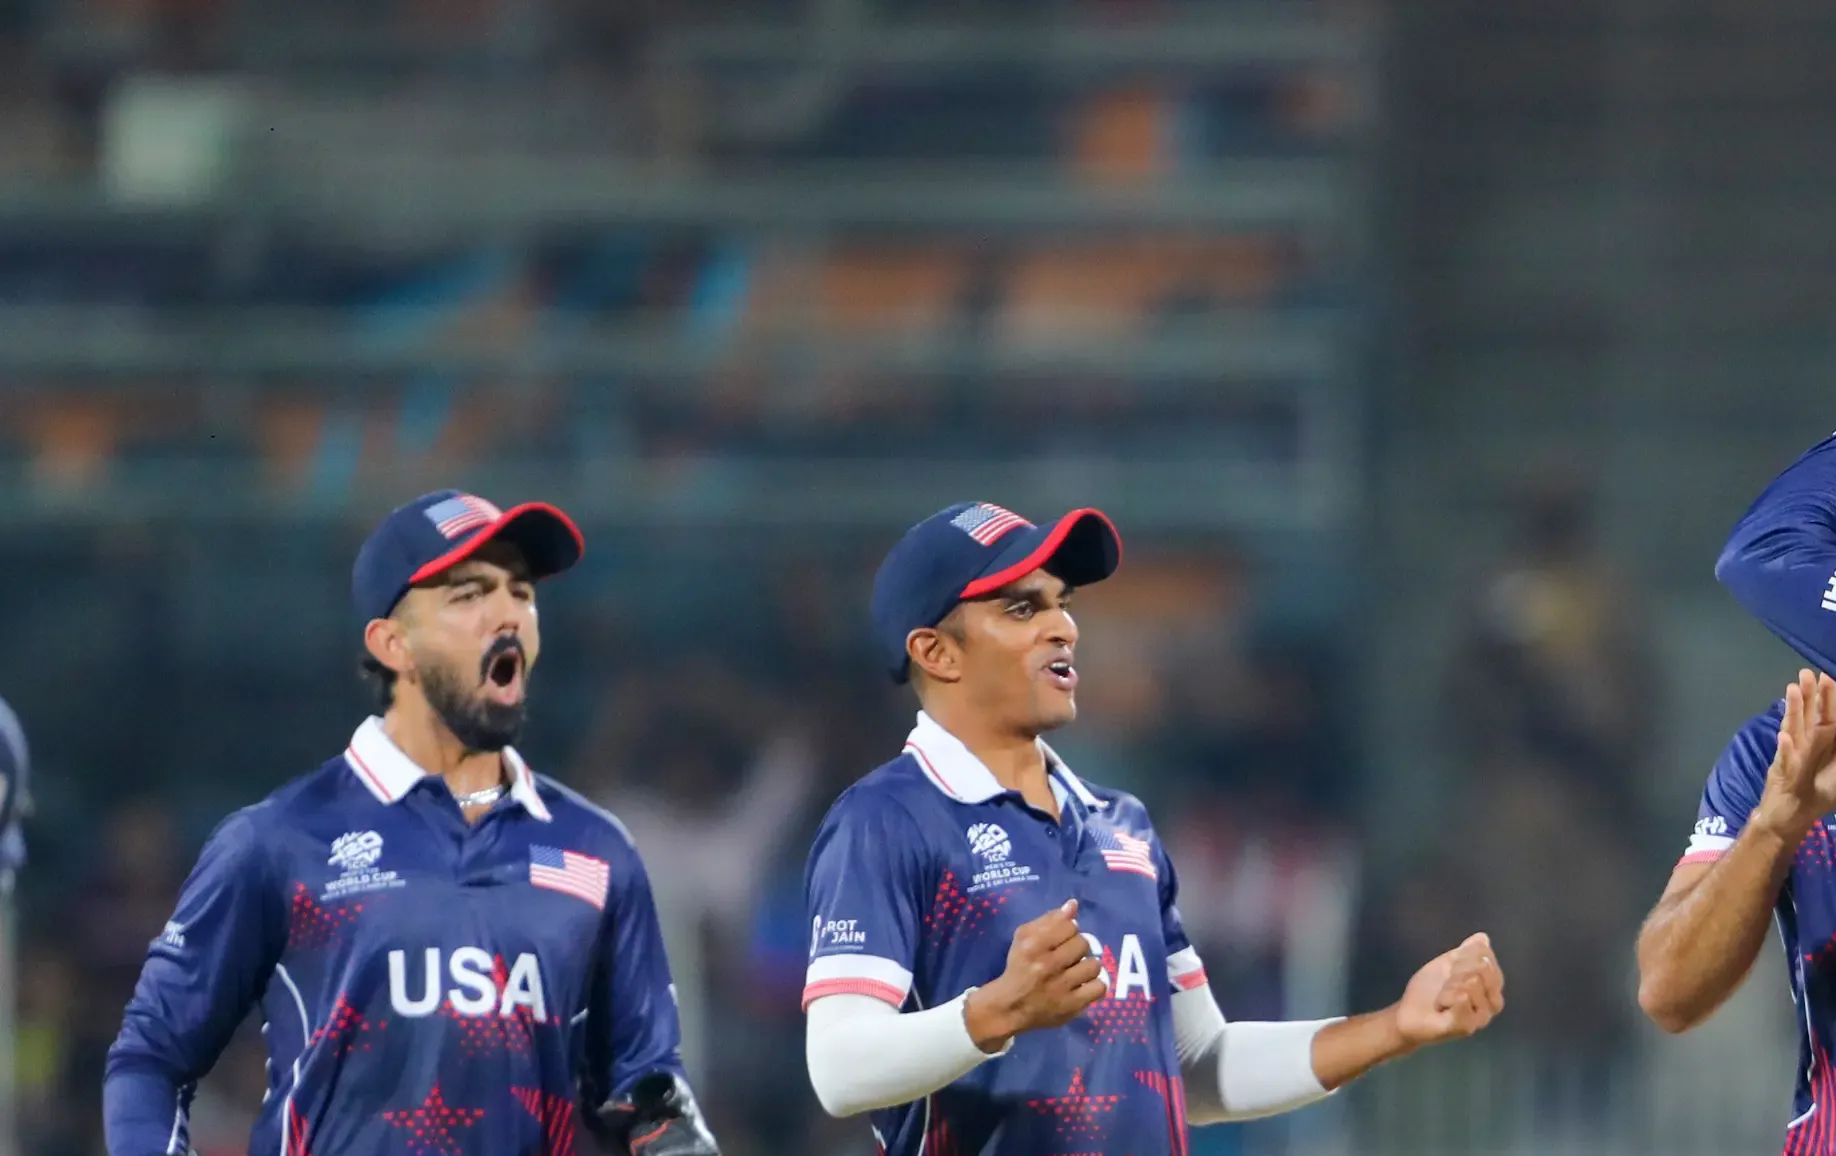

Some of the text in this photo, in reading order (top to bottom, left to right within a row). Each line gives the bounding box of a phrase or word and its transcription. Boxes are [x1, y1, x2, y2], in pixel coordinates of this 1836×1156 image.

[973, 868, 1010, 884] WORLD
[830, 931, 866, 944] JAIN
[387, 945, 547, 1024] USA
